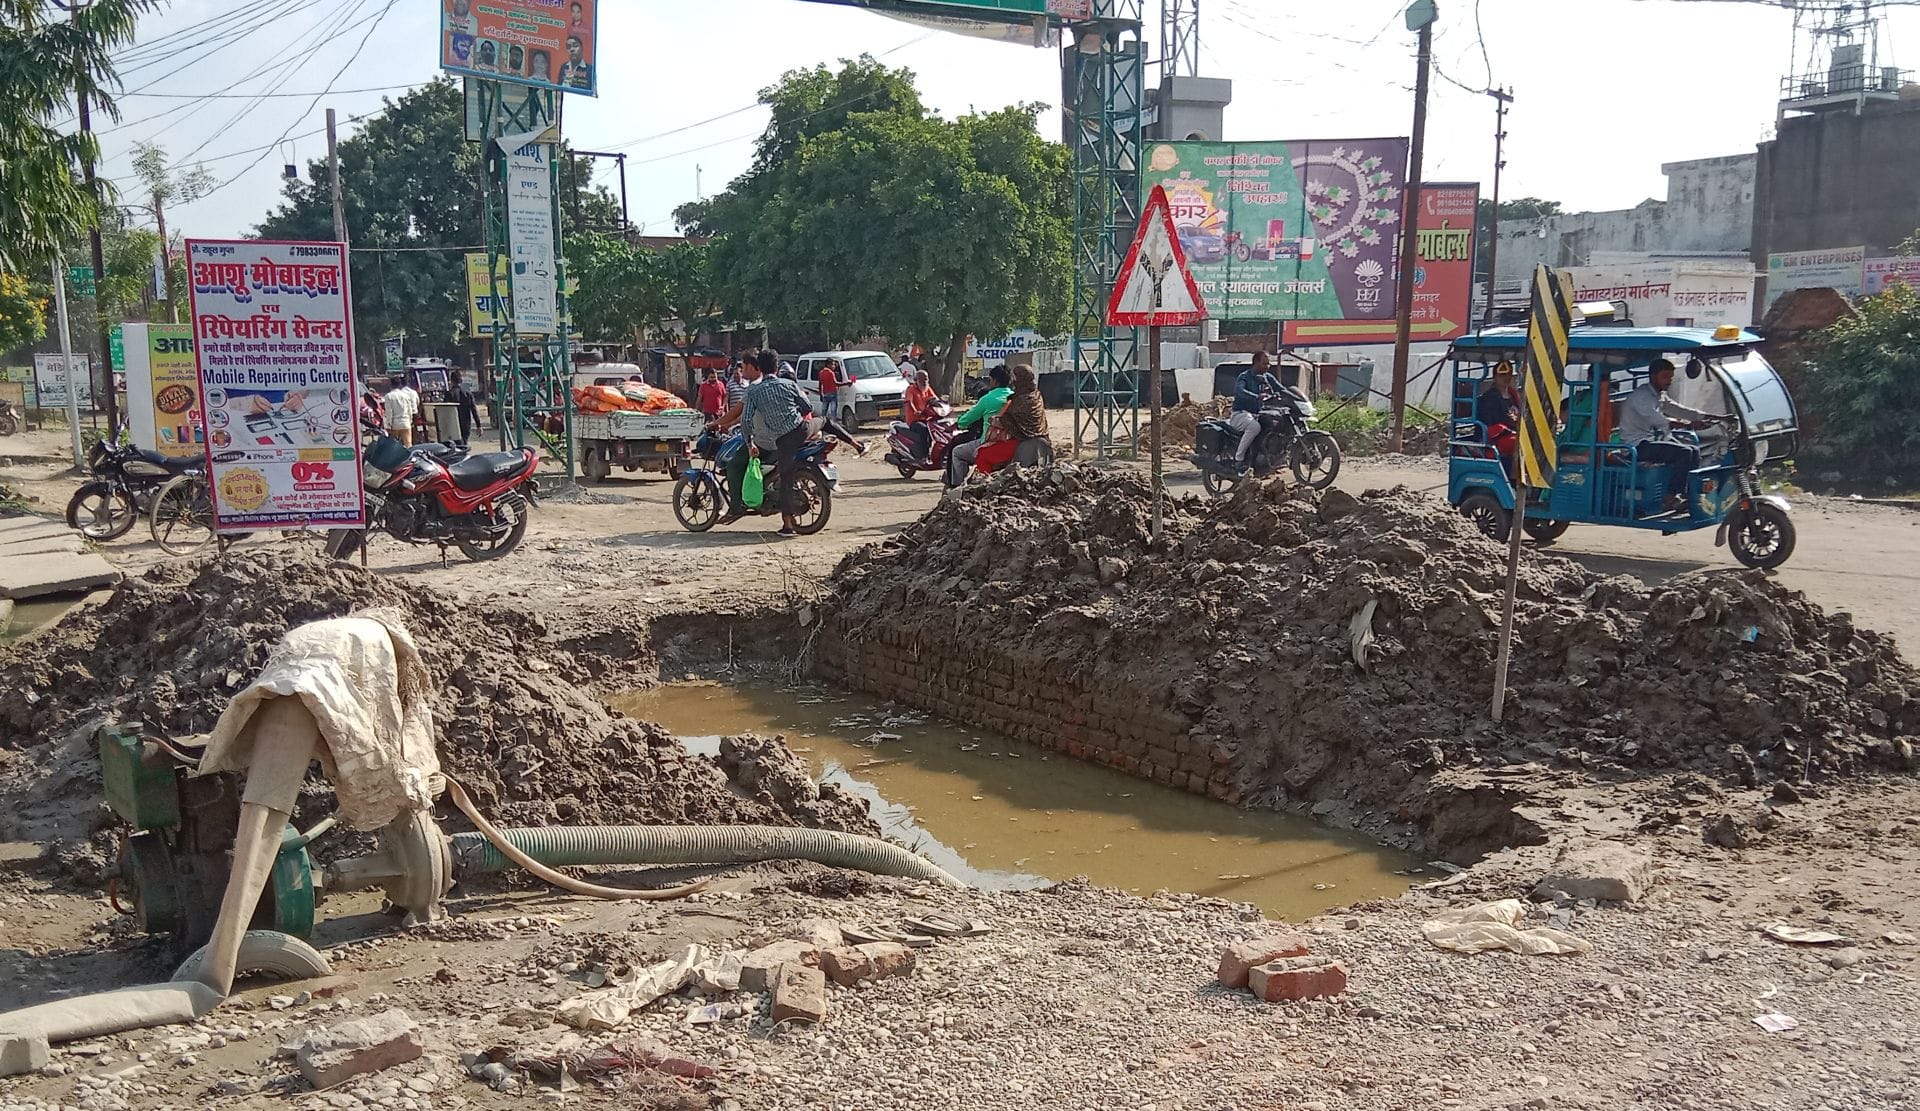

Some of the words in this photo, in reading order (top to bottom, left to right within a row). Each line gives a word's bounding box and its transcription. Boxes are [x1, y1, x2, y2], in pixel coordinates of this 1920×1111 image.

[1169, 204, 1208, 218] कार
[1800, 252, 1862, 266] ENTERPRISES
[195, 262, 251, 302] आशू
[251, 257, 339, 297] मोबाइल
[1220, 281, 1280, 293] श्यामलाल
[200, 314, 287, 339] रिपेयरिंग
[292, 315, 344, 339] सेन्टर
[335, 344, 343, 352] पर
[977, 349, 1019, 359] SCHO
[203, 368, 245, 384] Mobile
[248, 368, 306, 386] Repairing
[310, 367, 349, 383] Centre
[291, 462, 334, 482] 0%
